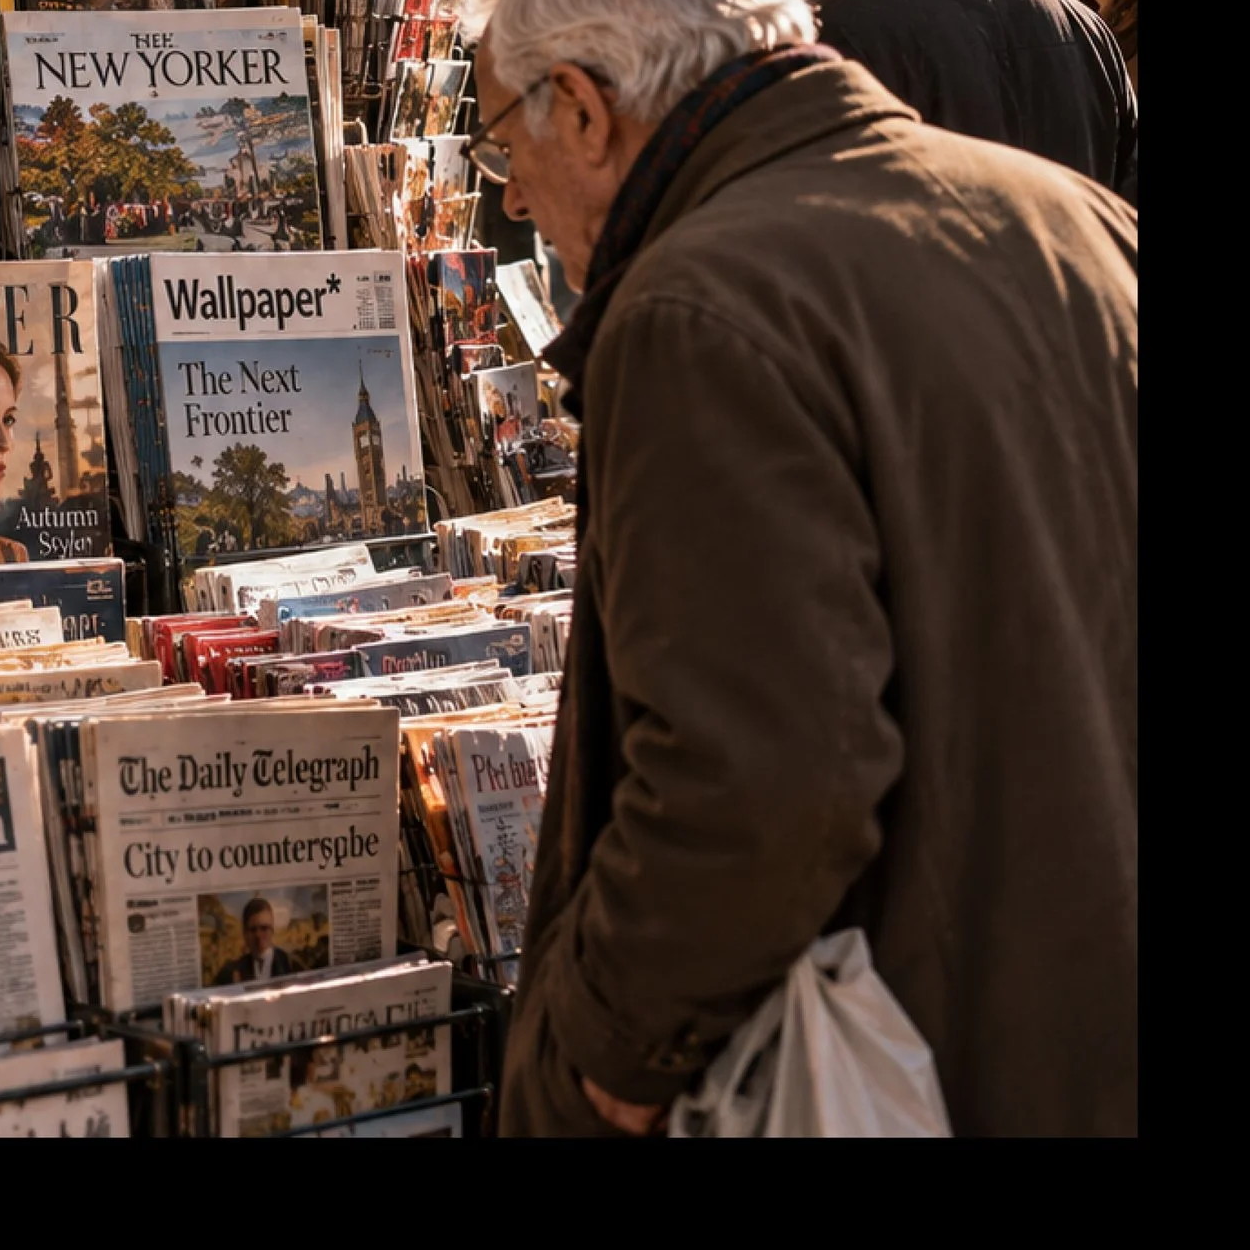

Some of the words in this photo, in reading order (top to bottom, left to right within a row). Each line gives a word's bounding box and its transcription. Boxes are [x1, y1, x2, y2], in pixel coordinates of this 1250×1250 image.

[34, 52, 130, 90] NEW
[137, 49, 290, 88] YORKER
[177, 361, 231, 397] The
[240, 362, 302, 395] Next
[183, 401, 293, 437] Frontier
[15, 506, 99, 530] Autumn
[118, 753, 172, 797] The
[177, 749, 247, 797] Daily
[252, 745, 380, 793] Telegraph
[124, 841, 180, 884] City
[187, 843, 213, 872] to
